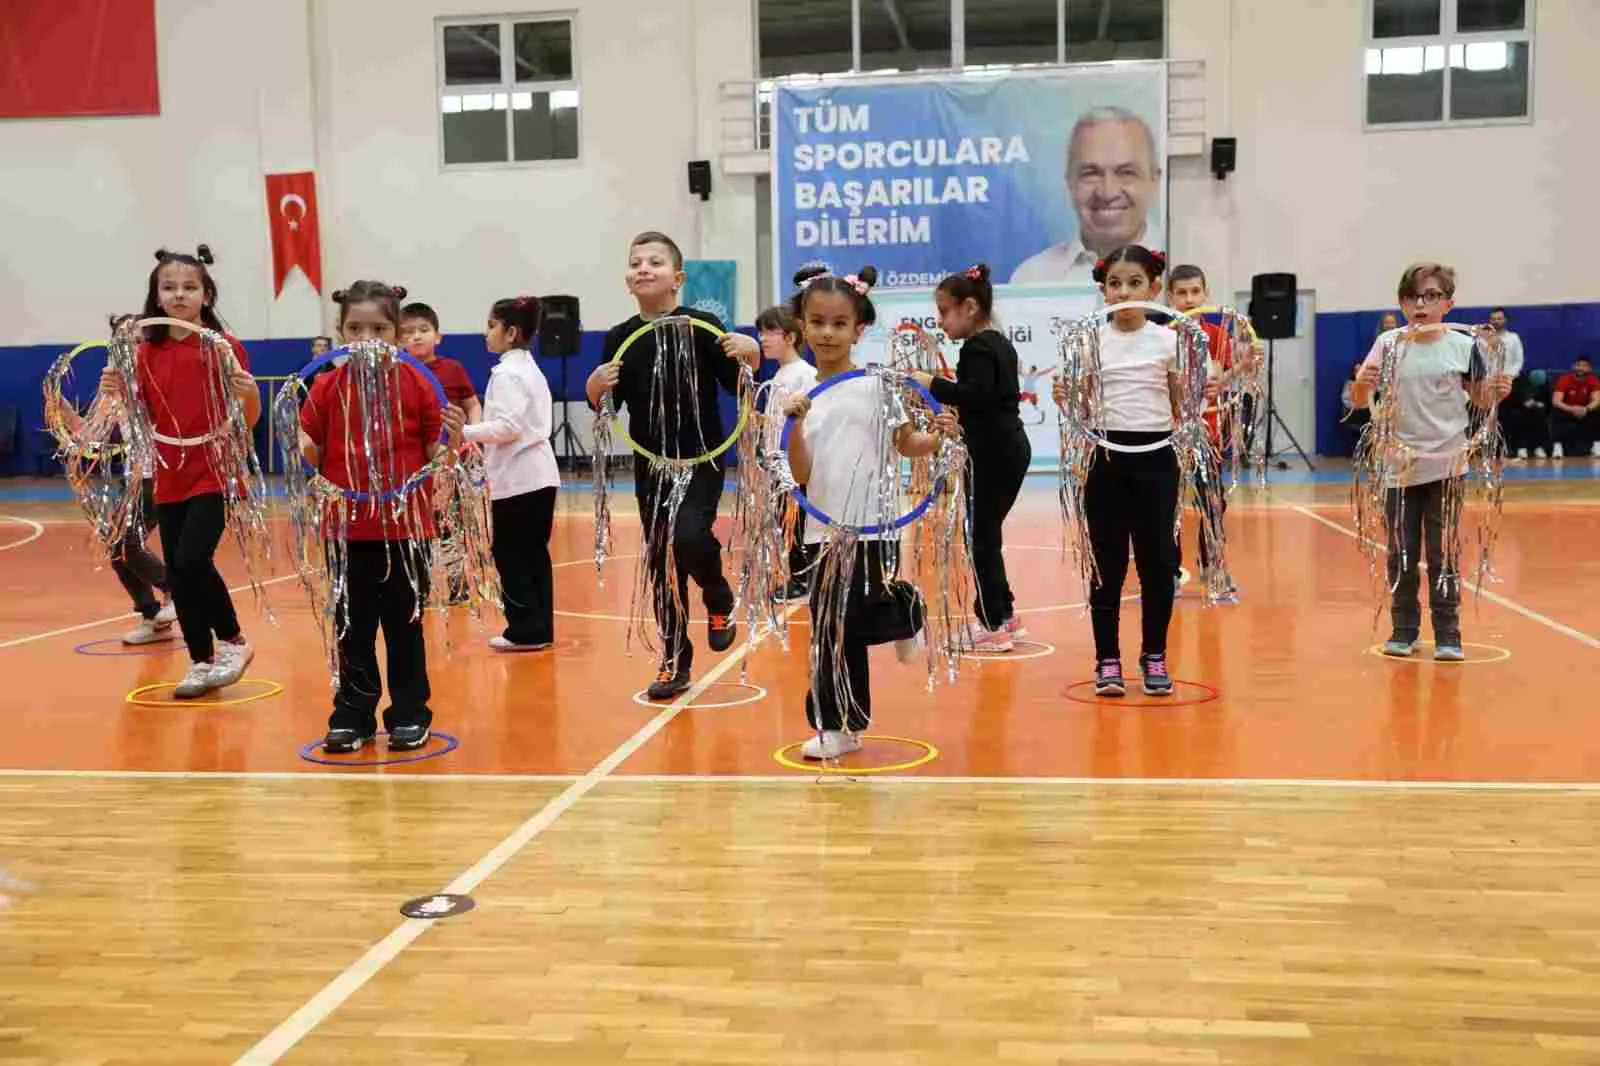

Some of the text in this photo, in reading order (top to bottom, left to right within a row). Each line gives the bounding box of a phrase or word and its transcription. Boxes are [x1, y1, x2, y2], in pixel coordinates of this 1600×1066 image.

[793, 98, 870, 133] TÜM
[794, 135, 1030, 171] SPORCULARA
[794, 176, 989, 216] BAŞARILAR
[795, 208, 931, 247] DİLERİM
